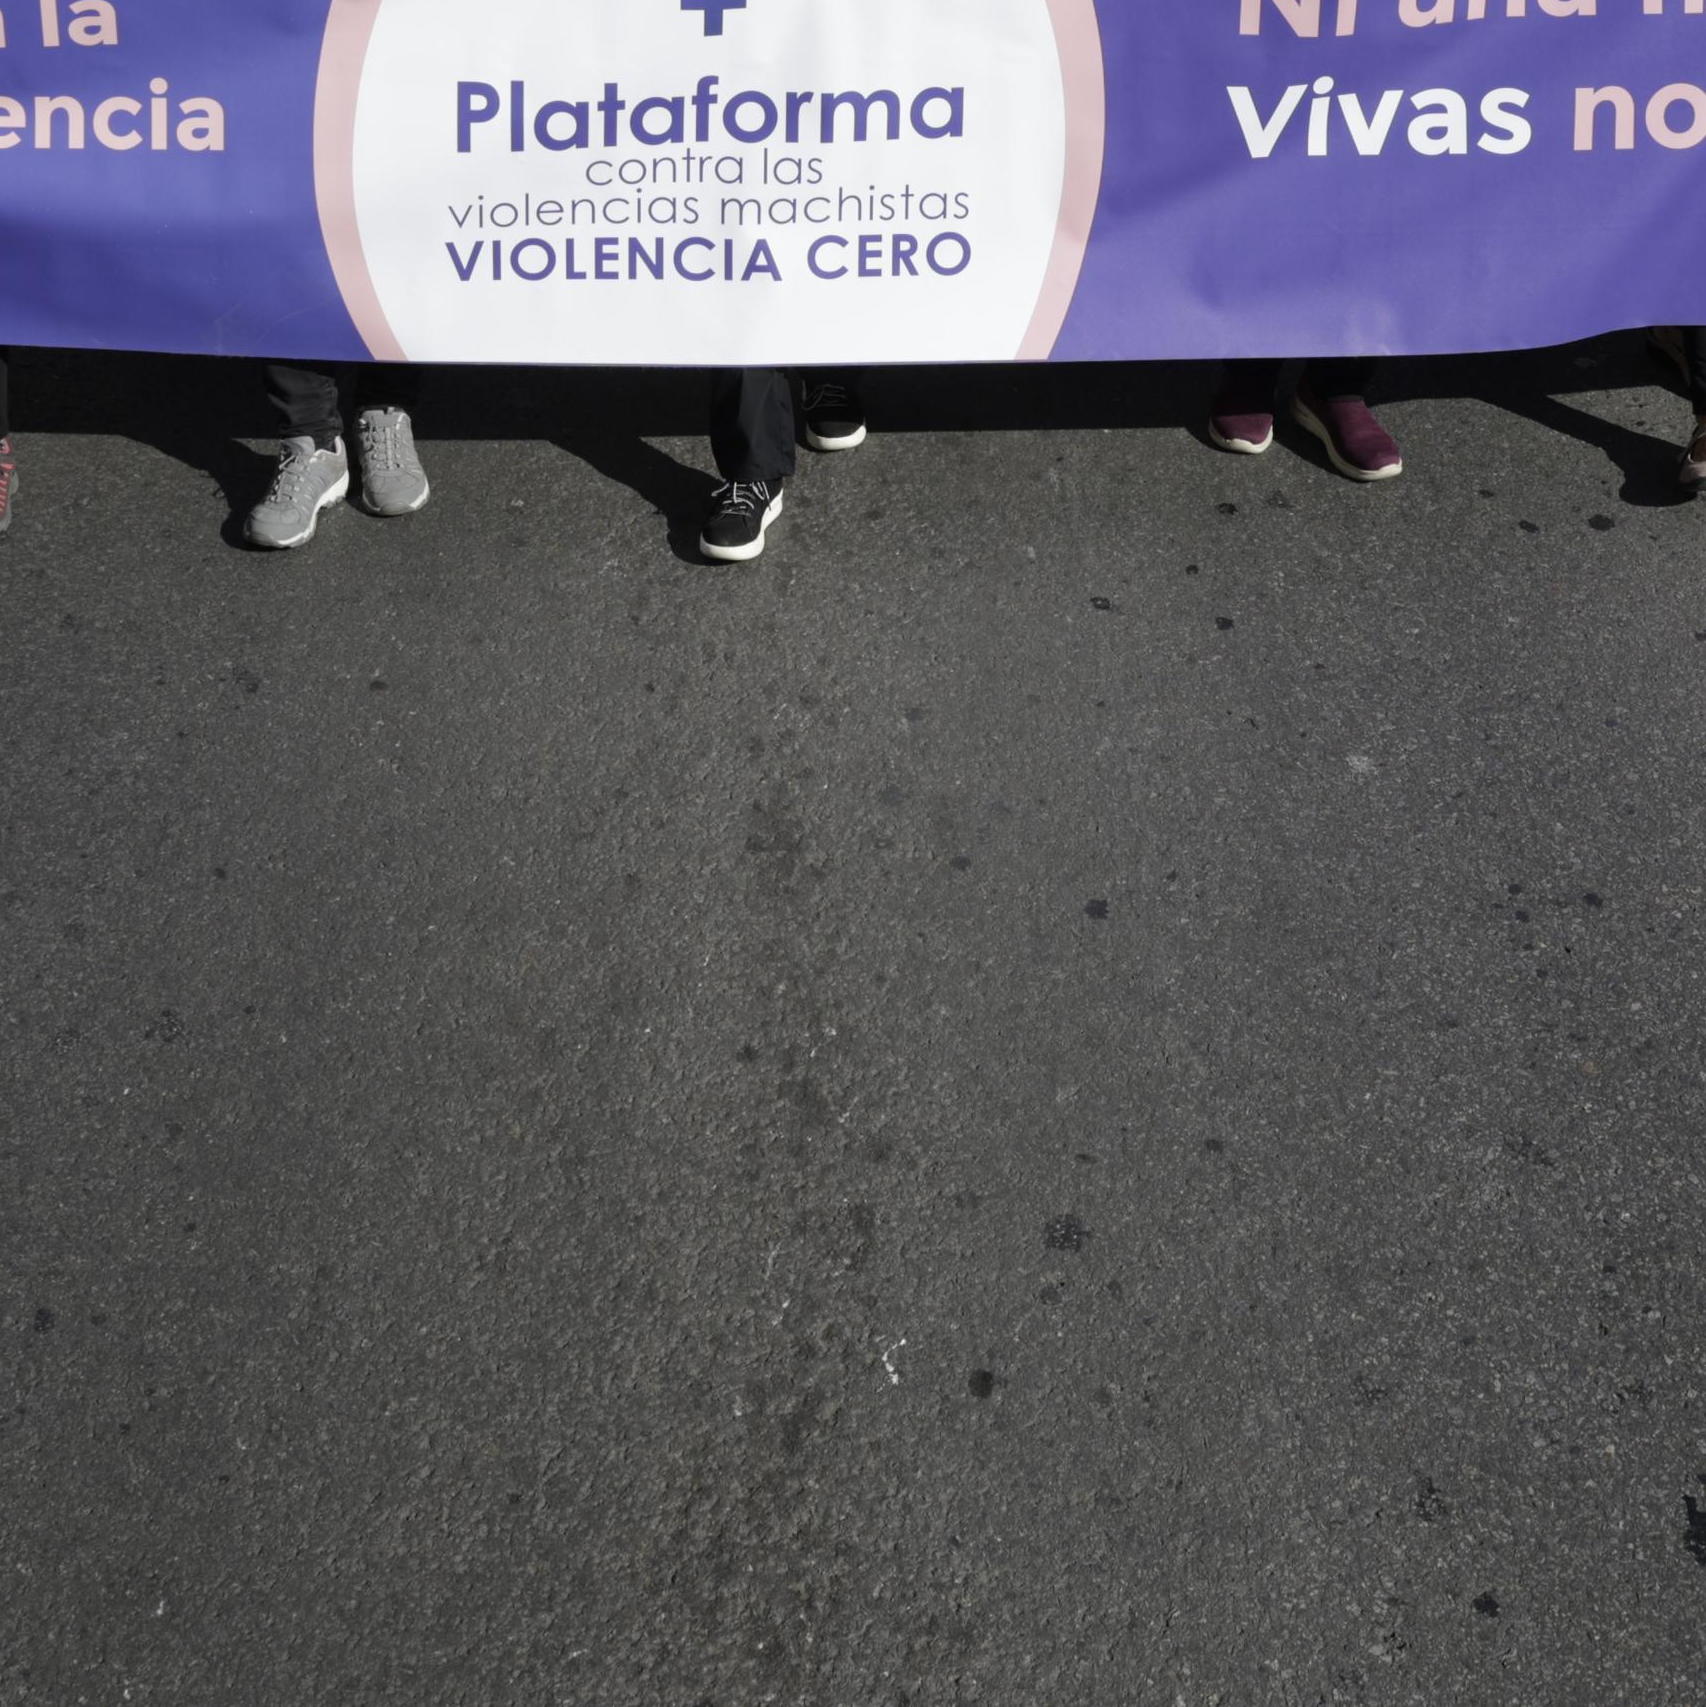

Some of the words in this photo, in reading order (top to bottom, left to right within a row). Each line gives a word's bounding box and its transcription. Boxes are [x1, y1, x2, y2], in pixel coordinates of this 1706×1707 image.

[456, 74, 965, 154] Plataforma
[1226, 75, 1532, 160] Vivas
[586, 147, 744, 186] contra
[762, 148, 824, 185] las
[447, 188, 701, 229] violencias
[720, 184, 971, 227] machistas
[444, 236, 783, 282] VIOLENCIA
[807, 231, 972, 280] CERO
